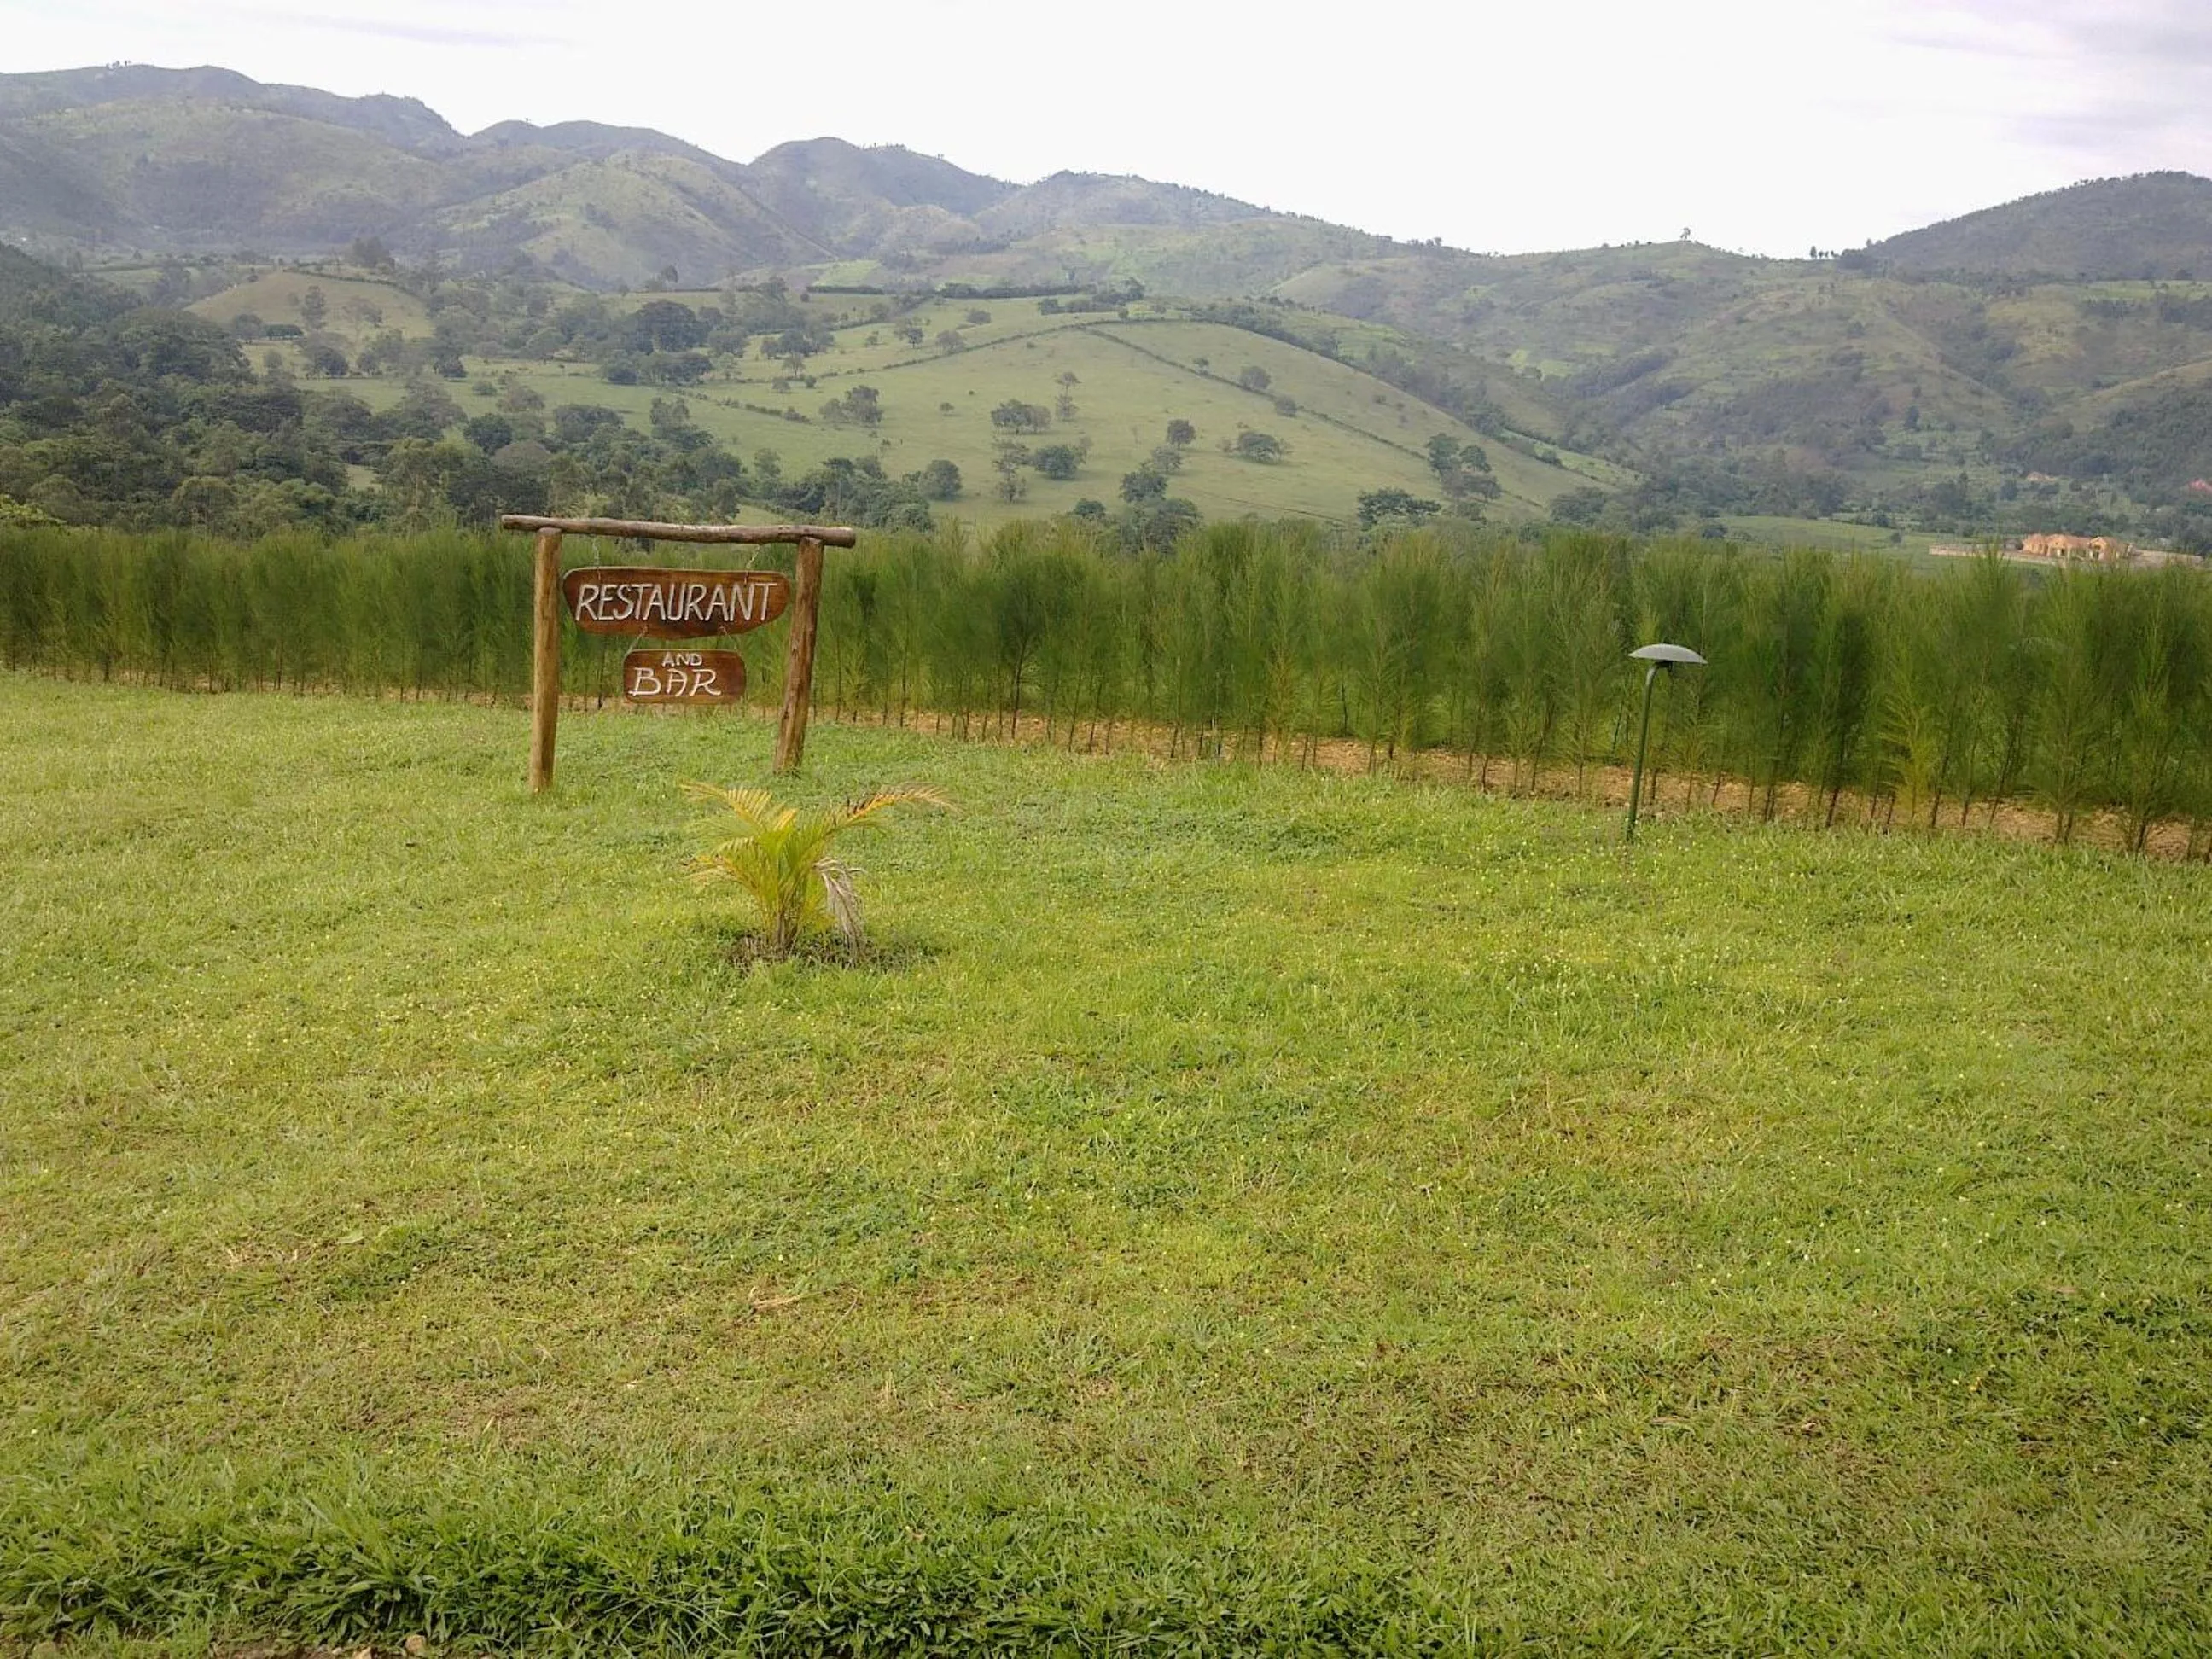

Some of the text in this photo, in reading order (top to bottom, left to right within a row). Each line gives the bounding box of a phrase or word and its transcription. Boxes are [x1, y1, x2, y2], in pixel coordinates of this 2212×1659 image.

[575, 583, 777, 621] RESTAURANT
[662, 652, 702, 667] AND
[628, 667, 722, 697] BAR
